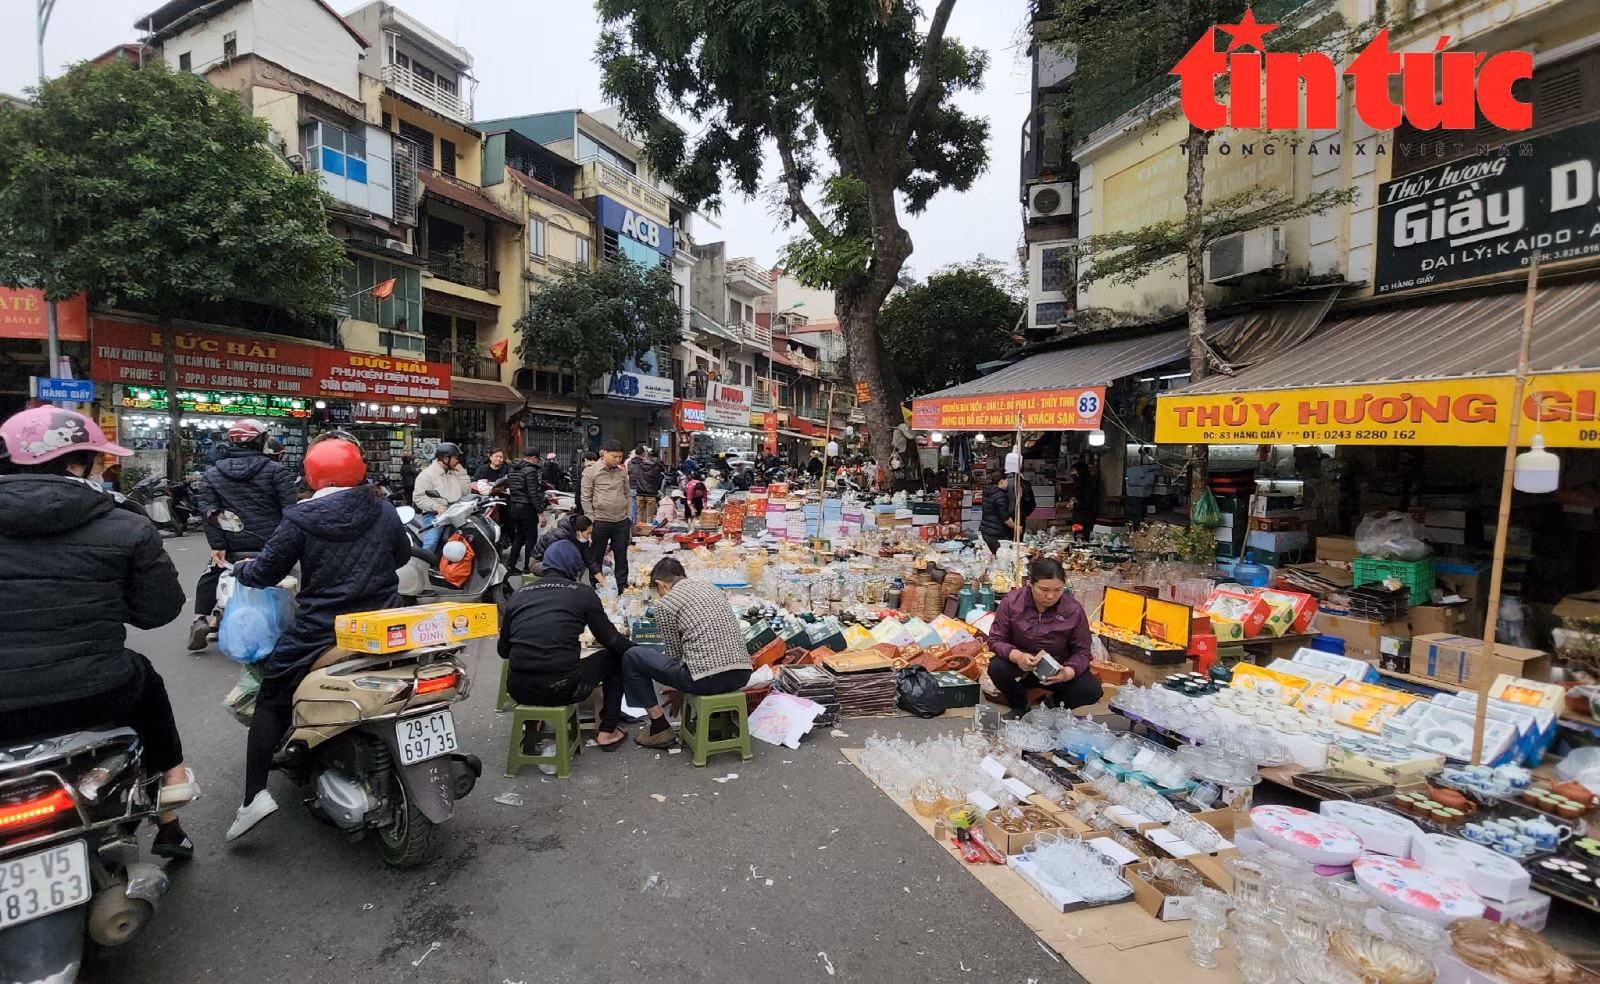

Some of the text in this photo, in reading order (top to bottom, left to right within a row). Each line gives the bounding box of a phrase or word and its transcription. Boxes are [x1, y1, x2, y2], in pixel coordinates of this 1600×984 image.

[1393, 181, 1525, 248] Giầy
[621, 209, 660, 248] ACB
[1421, 252, 1456, 271] ĐẠI
[1497, 229, 1571, 256] KAIDO
[1391, 278, 1414, 290] HÀNG
[1416, 272, 1437, 284] GIẤY
[330, 366, 356, 380] PHỤ
[348, 355, 428, 374] ĐỨC HẢI
[120, 366, 153, 380] IPHONE
[185, 372, 206, 384] OPPO
[211, 374, 249, 388] SAMSUNG
[253, 378, 272, 389] SONY
[607, 374, 640, 397] ACB
[1079, 396, 1098, 413] 83
[1173, 395, 1281, 428] THỦY
[1297, 393, 1498, 425] HƯƠNG
[1028, 410, 1055, 425] KHÁCH
[1056, 412, 1075, 427] SẠN
[1219, 431, 1231, 439] 83
[1233, 429, 1258, 440] HÀNG
[1260, 427, 1283, 440] GIẤY
[1323, 430, 1352, 440] 0243
[1355, 430, 1388, 440] 8280
[1393, 430, 1416, 440] 162
[405, 715, 447, 741] 29-C1
[404, 732, 456, 761] 697.35
[0, 874, 83, 924] 83.63
